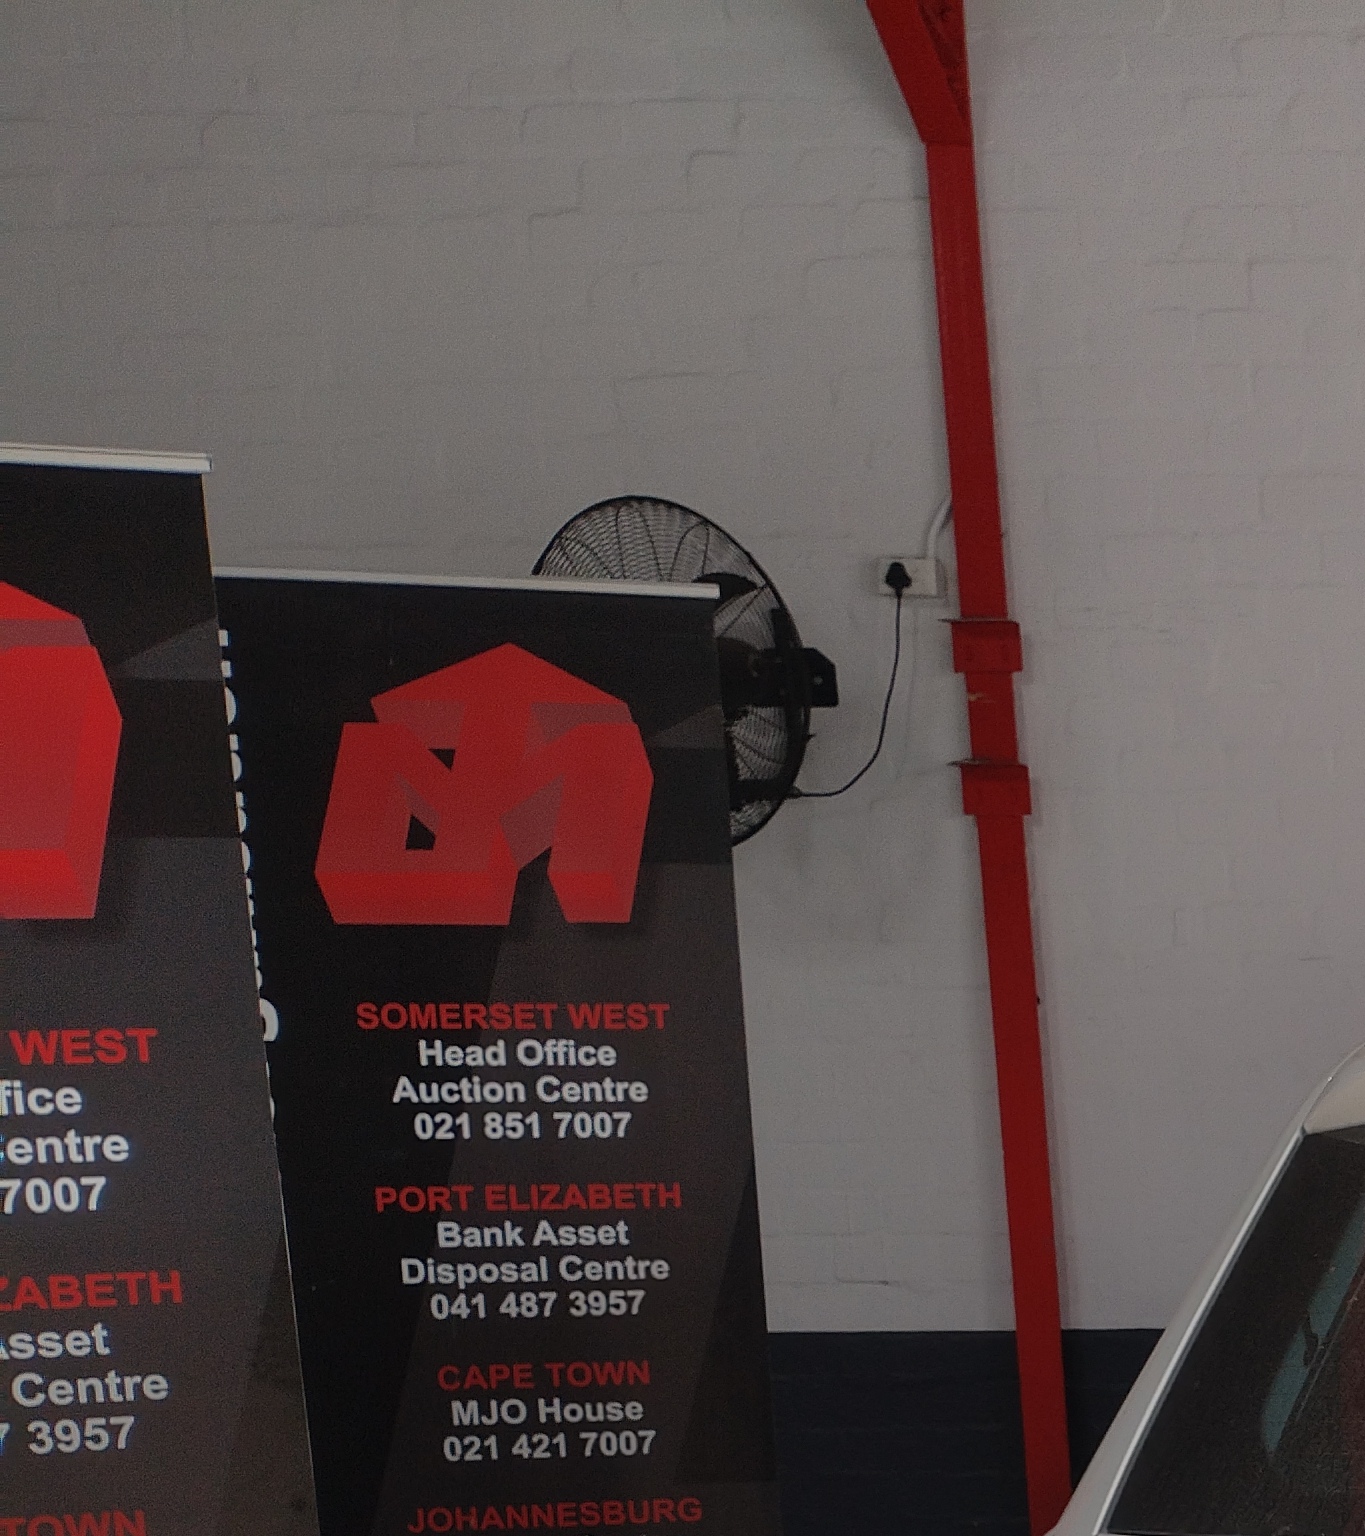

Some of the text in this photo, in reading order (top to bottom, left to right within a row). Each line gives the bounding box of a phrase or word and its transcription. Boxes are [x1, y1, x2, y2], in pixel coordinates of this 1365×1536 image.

[356, 1002, 669, 1030] SOMERSET WEST
[9, 1028, 157, 1065] WEST
[418, 1038, 617, 1067] Head Office
[392, 1075, 649, 1104] Auction Centre
[414, 1111, 632, 1140] 021 851 7007
[0, 1128, 129, 1165] entre
[374, 1182, 682, 1213] PORT ELIZABETH
[437, 1219, 630, 1248] Bank Asset
[400, 1254, 670, 1290] Disposal Centre
[430, 1289, 646, 1320] 041 487 3957
[11, 1369, 169, 1408] Centre
[437, 1360, 651, 1391] CAPE TOWN
[451, 1397, 644, 1426] MJO House
[27, 1415, 135, 1455] 3957
[443, 1429, 657, 1462] 021 421 7007
[407, 1496, 703, 1534] JOHANNESBURG
